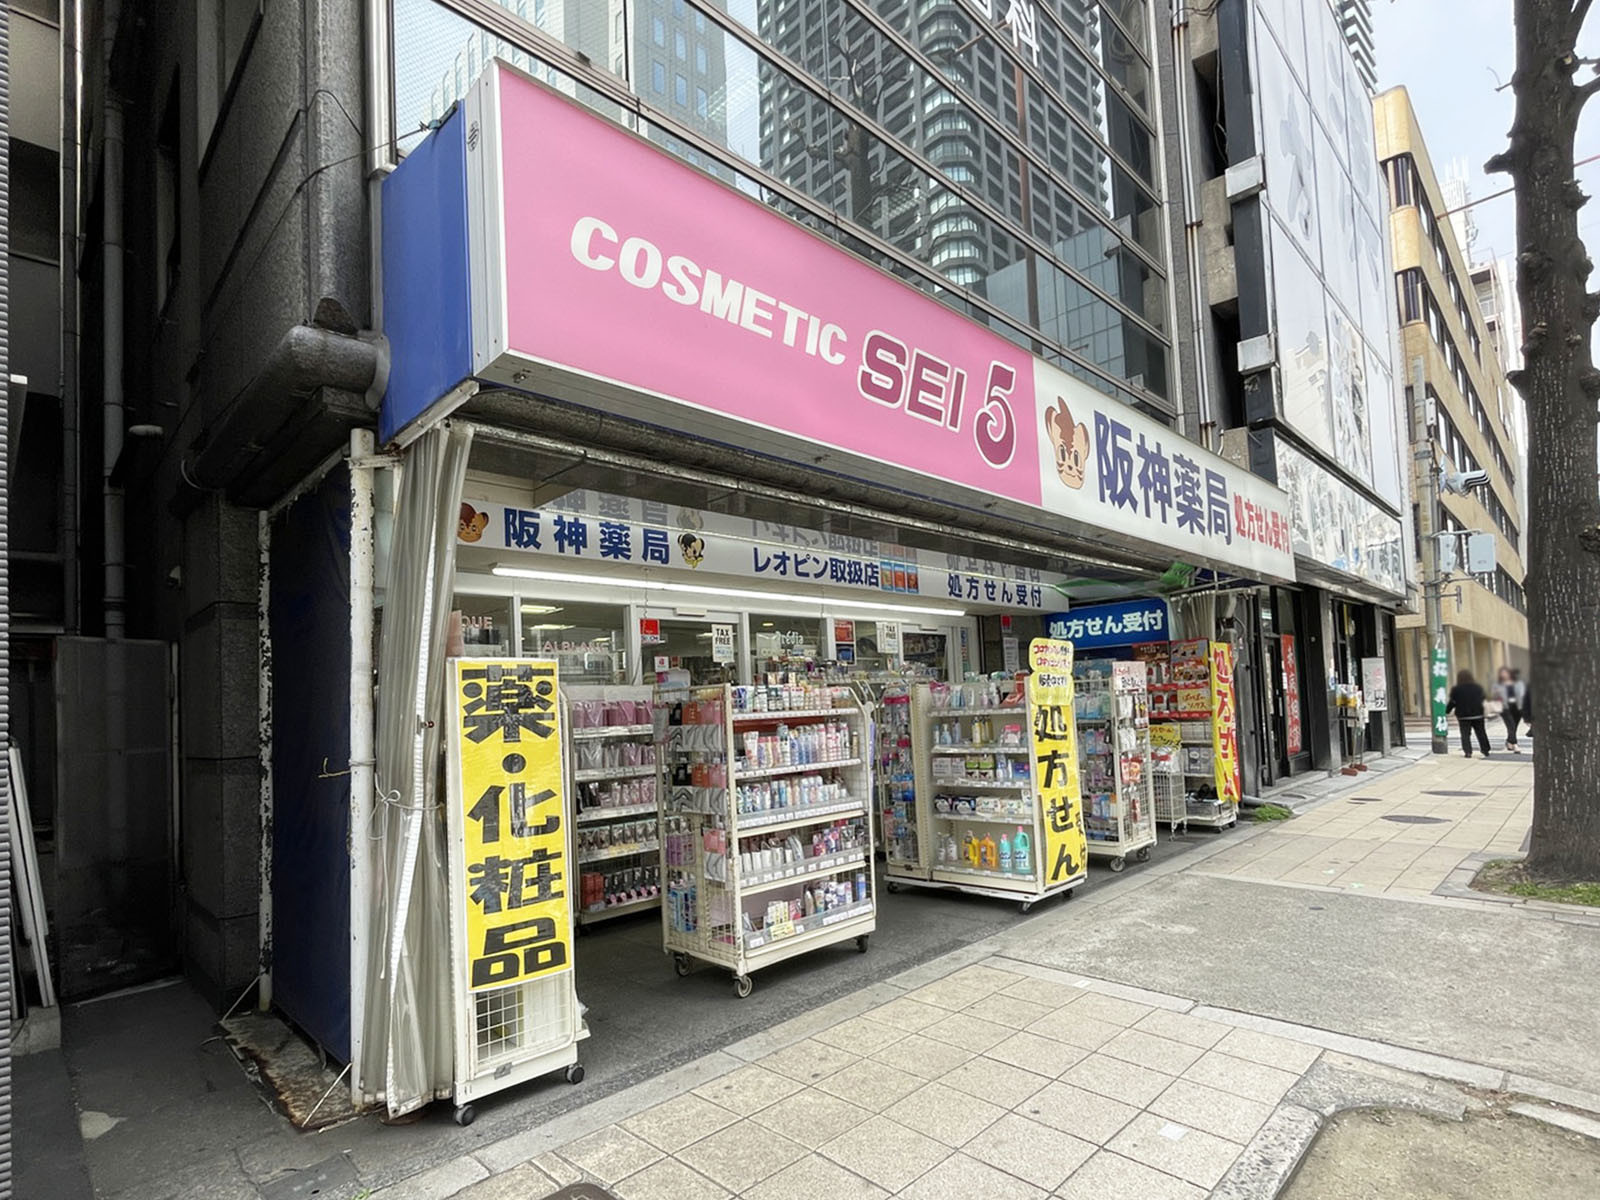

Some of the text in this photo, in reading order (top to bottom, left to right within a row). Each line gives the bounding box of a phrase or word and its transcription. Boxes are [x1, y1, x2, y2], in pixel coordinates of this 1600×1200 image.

[570, 216, 1017, 469] COSMETIC SEI 5
[1094, 410, 1232, 546] 阪神薬局
[503, 507, 671, 565] 阪神薬局
[1233, 492, 1290, 555] 処方せん受付
[753, 547, 880, 587] レオピン取扱店
[948, 574, 1042, 608] 処方せん受付
[715, 636, 731, 645] FREE
[716, 628, 730, 636] TAX
[1049, 608, 1164, 640] 処方せん受付
[1034, 704, 1080, 882] 処方せん
[462, 664, 566, 988] 薬・化粧品
